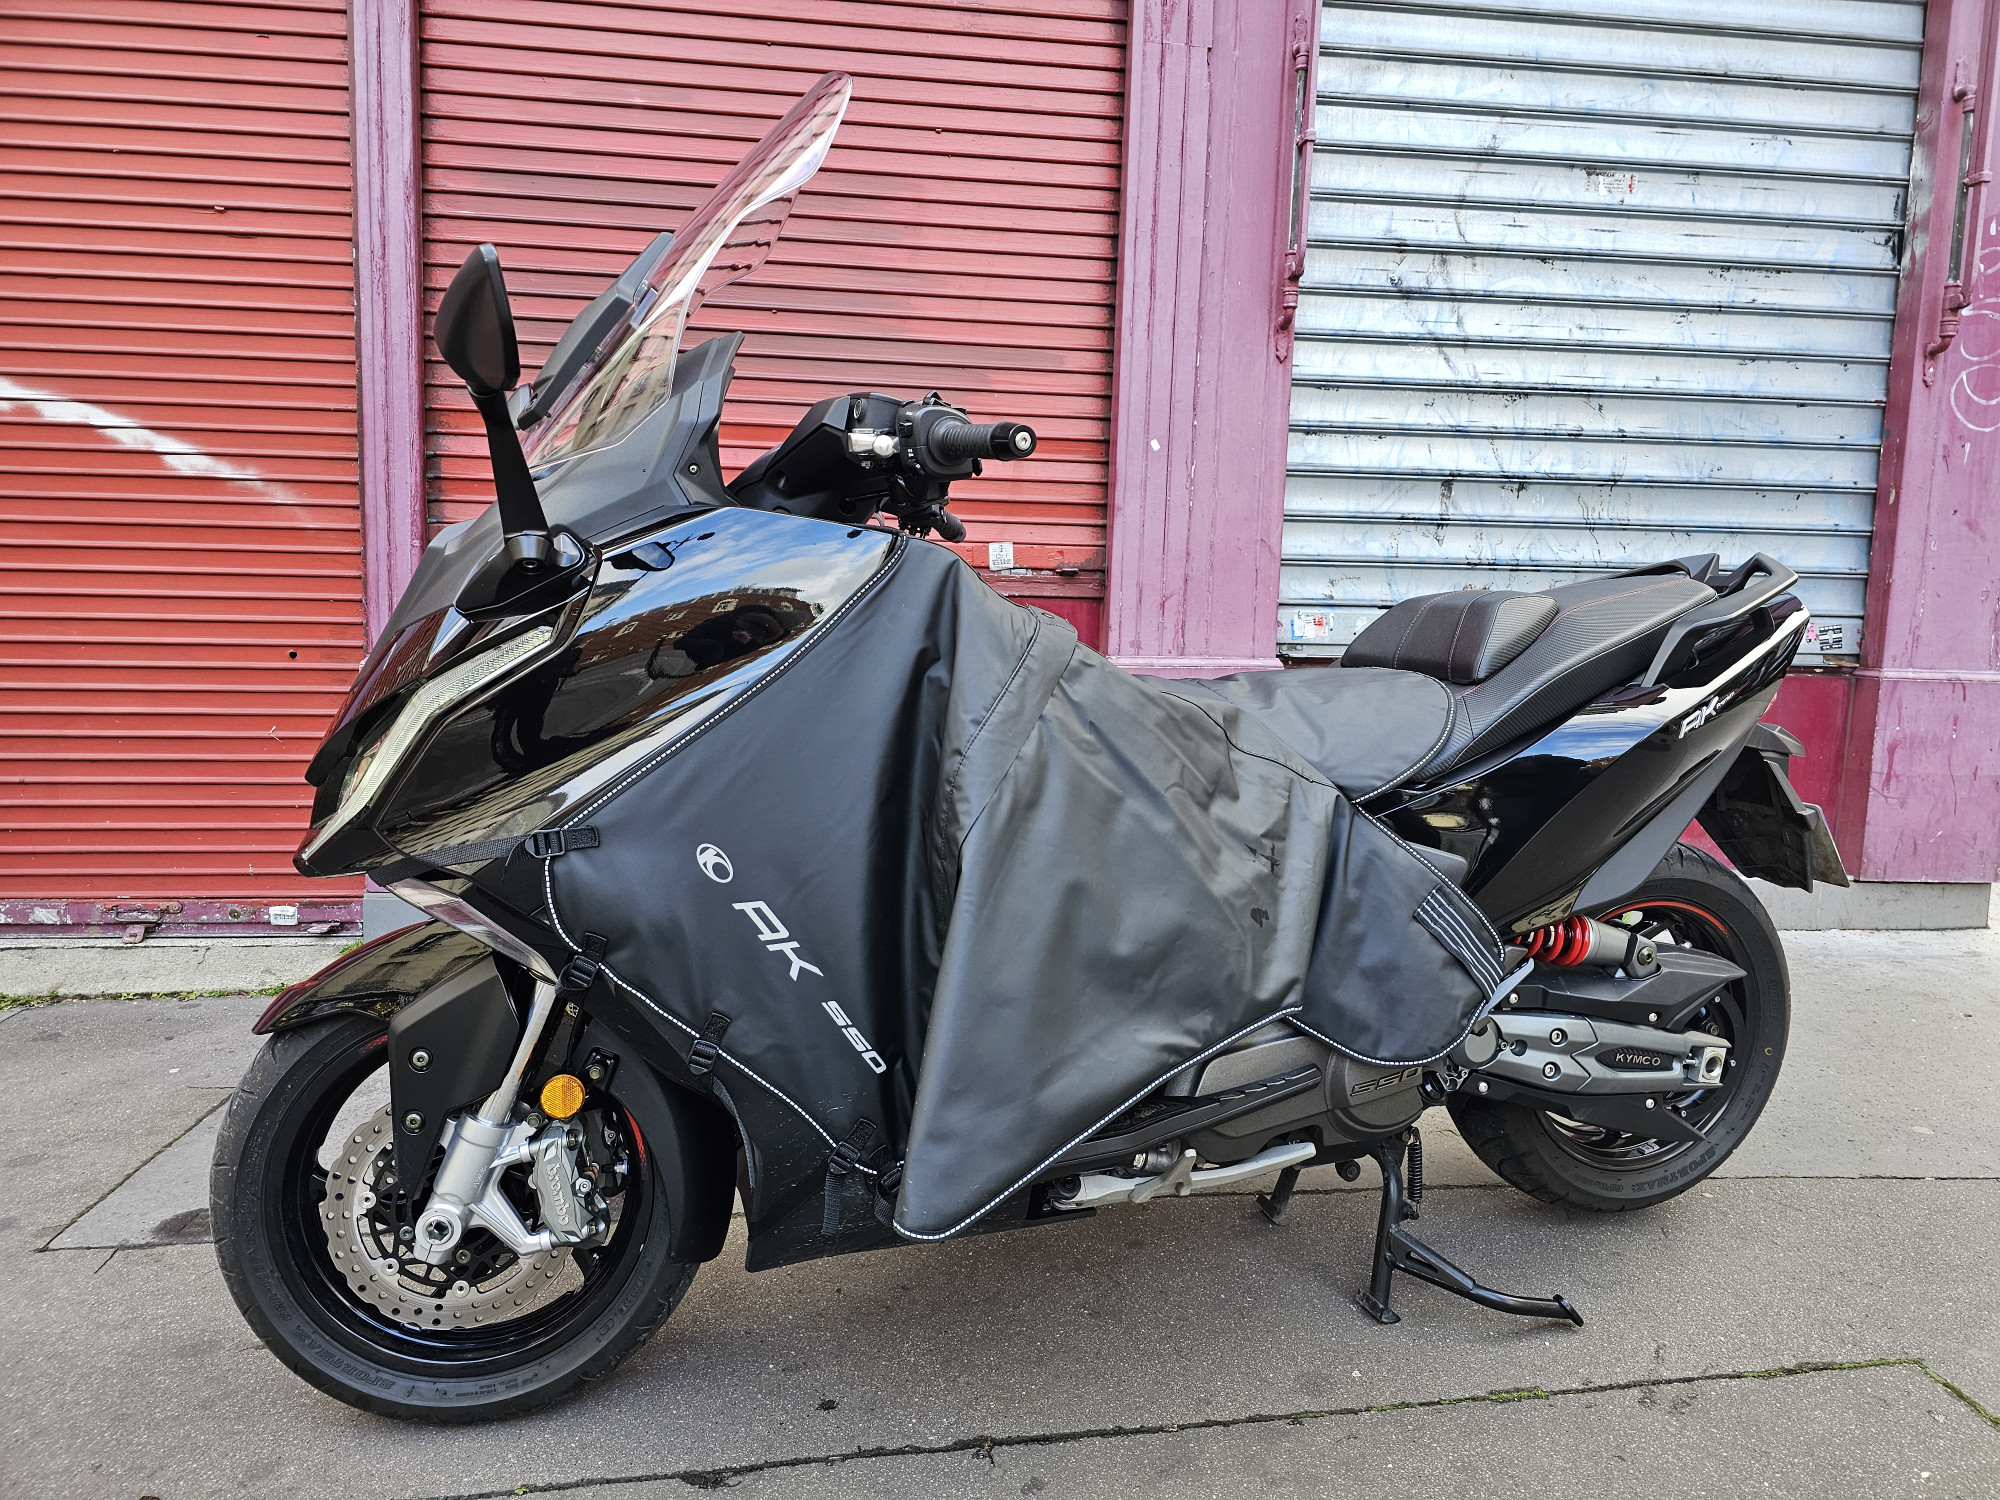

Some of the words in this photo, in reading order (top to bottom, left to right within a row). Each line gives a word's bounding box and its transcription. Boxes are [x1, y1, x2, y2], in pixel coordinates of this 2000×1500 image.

[731, 900, 824, 982] AK
[821, 1000, 887, 1074] 550
[1349, 1066, 1423, 1097] 550
[1615, 1053, 1661, 1066] KYMCO
[546, 1163, 570, 1226] brembo
